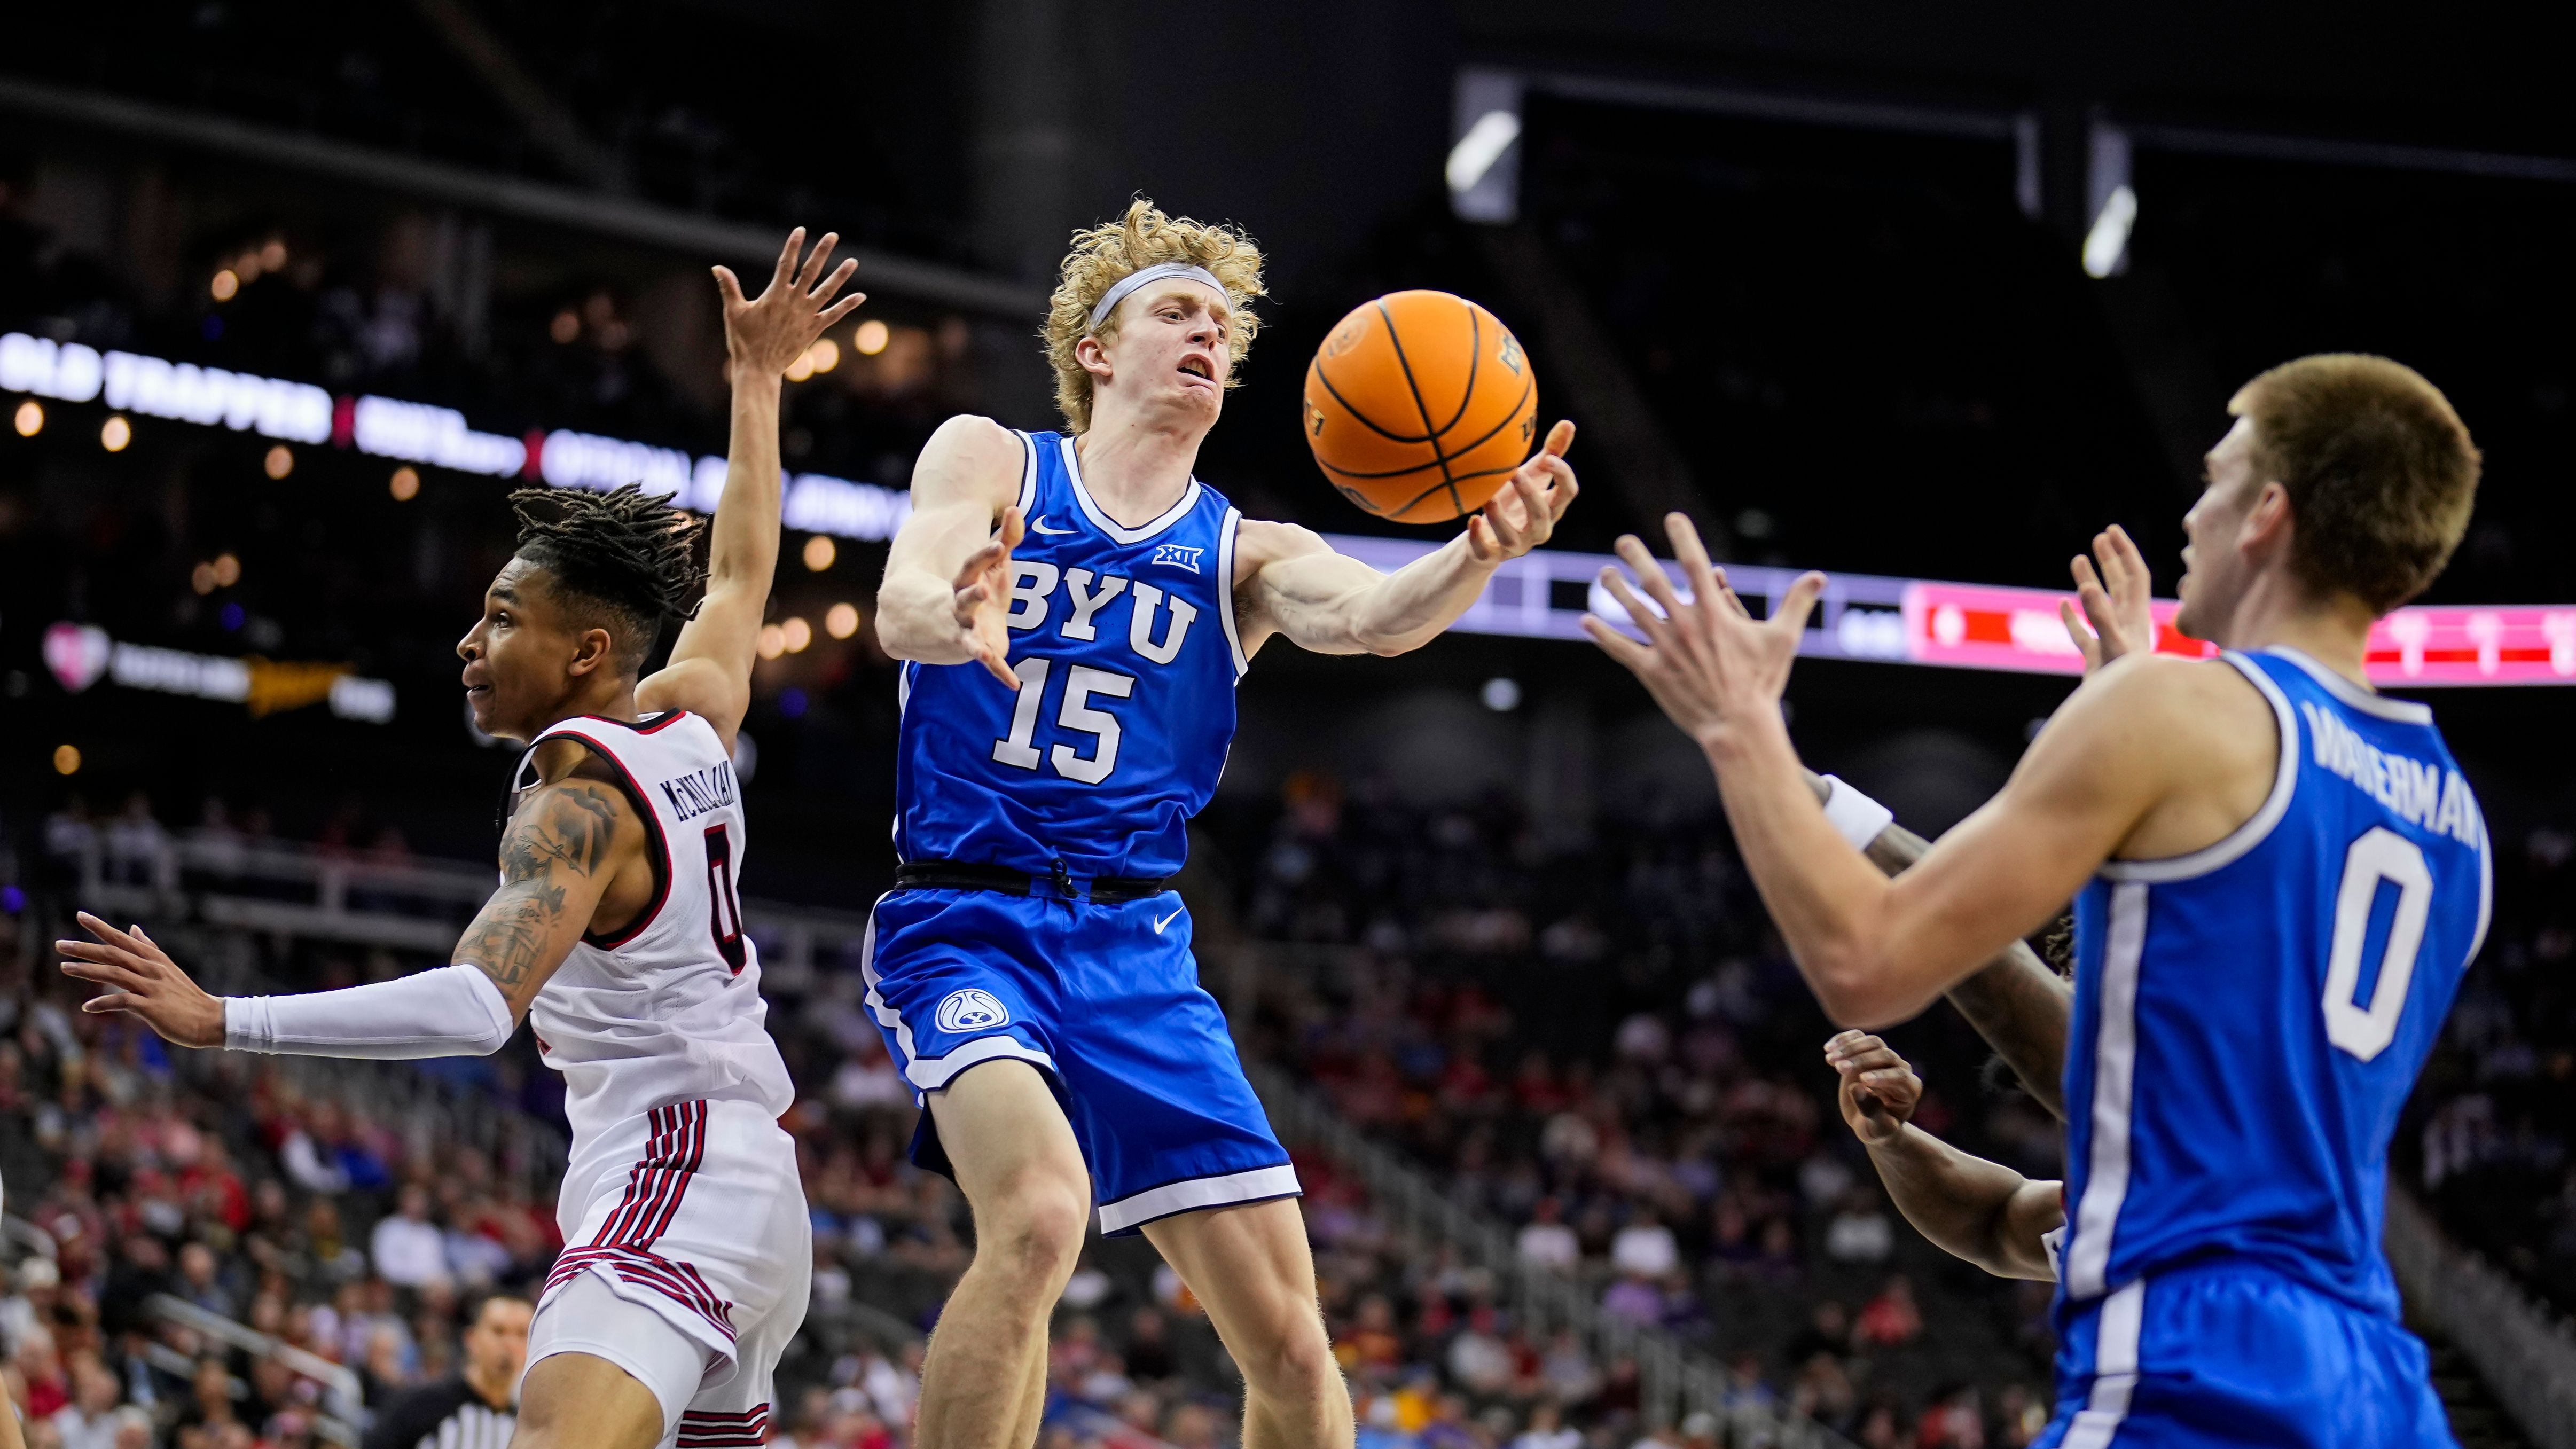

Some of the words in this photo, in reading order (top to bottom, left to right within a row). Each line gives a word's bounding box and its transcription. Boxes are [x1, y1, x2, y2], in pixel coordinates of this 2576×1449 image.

[1007, 560, 1199, 665] BYU
[992, 657, 1136, 786] 15
[704, 823, 747, 977] 0
[2322, 825, 2434, 1064] 0
